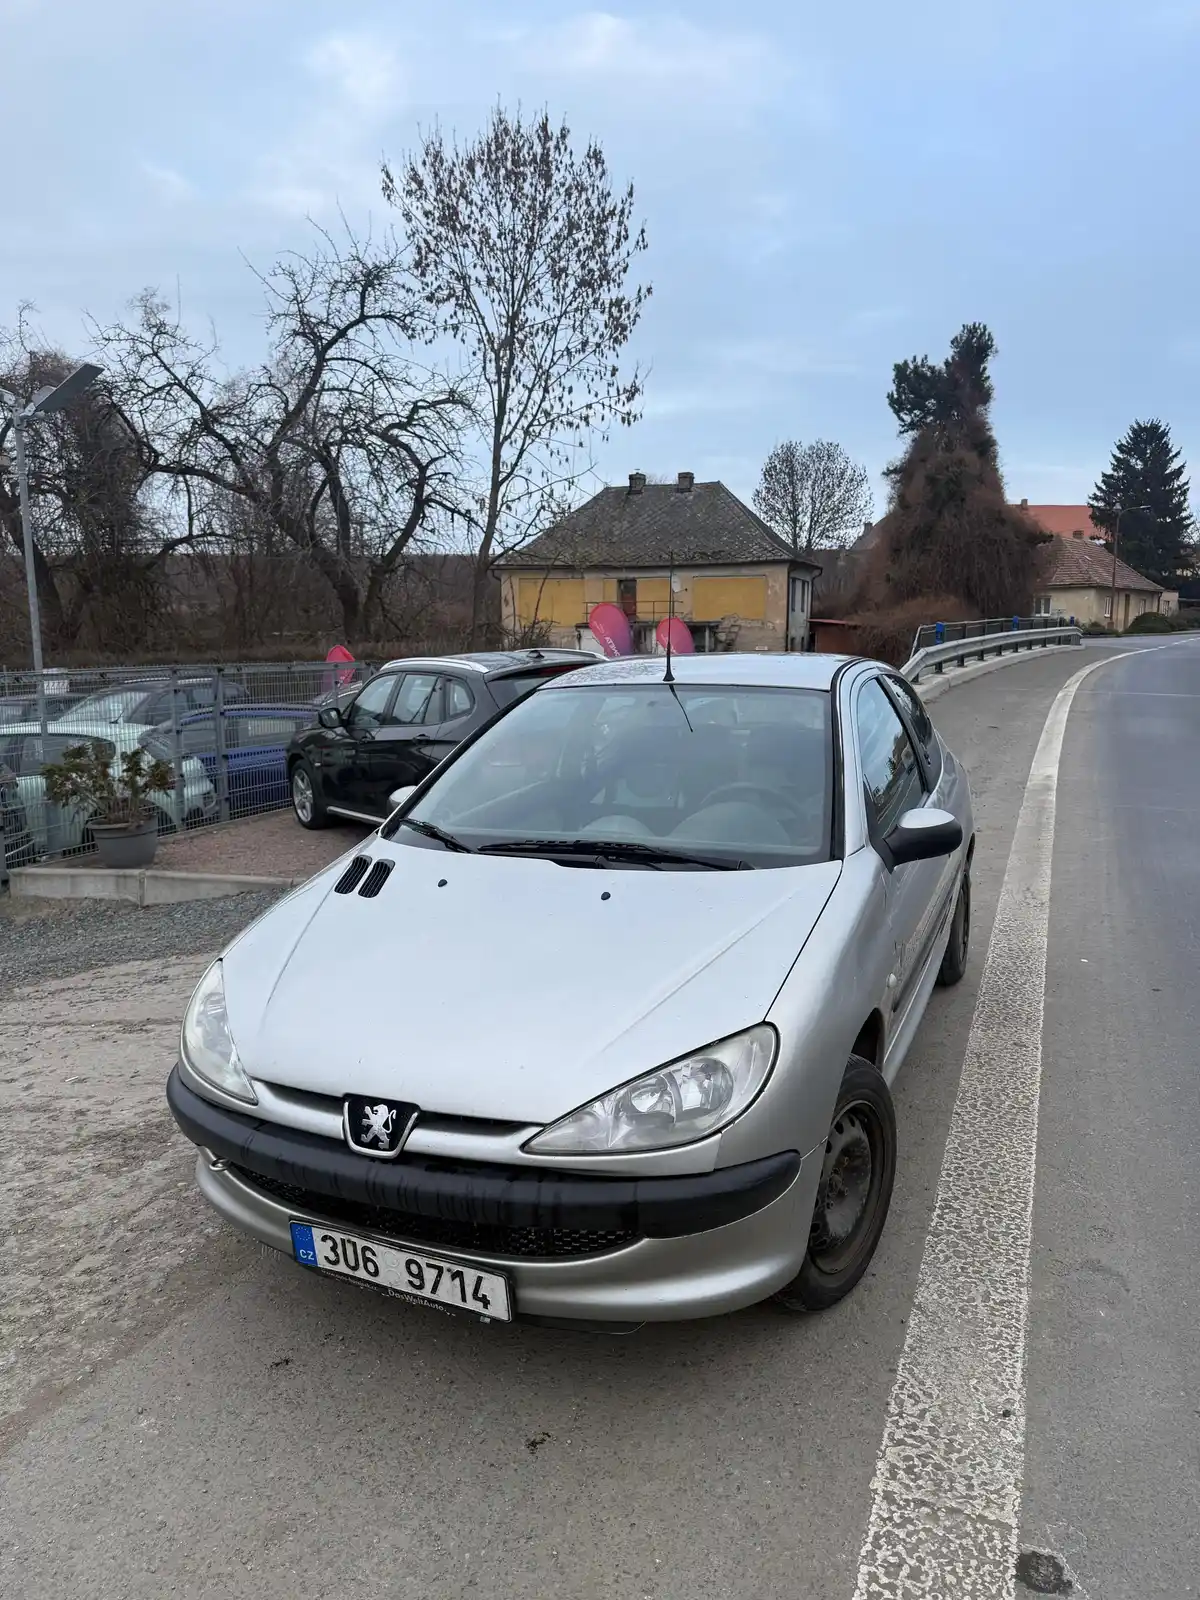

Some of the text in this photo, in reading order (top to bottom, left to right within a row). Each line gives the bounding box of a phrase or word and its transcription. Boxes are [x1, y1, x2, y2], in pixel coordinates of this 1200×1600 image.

[299, 1249, 315, 1260] CZ
[320, 1234, 380, 1278] 3U6
[404, 1258, 491, 1310] 9714
